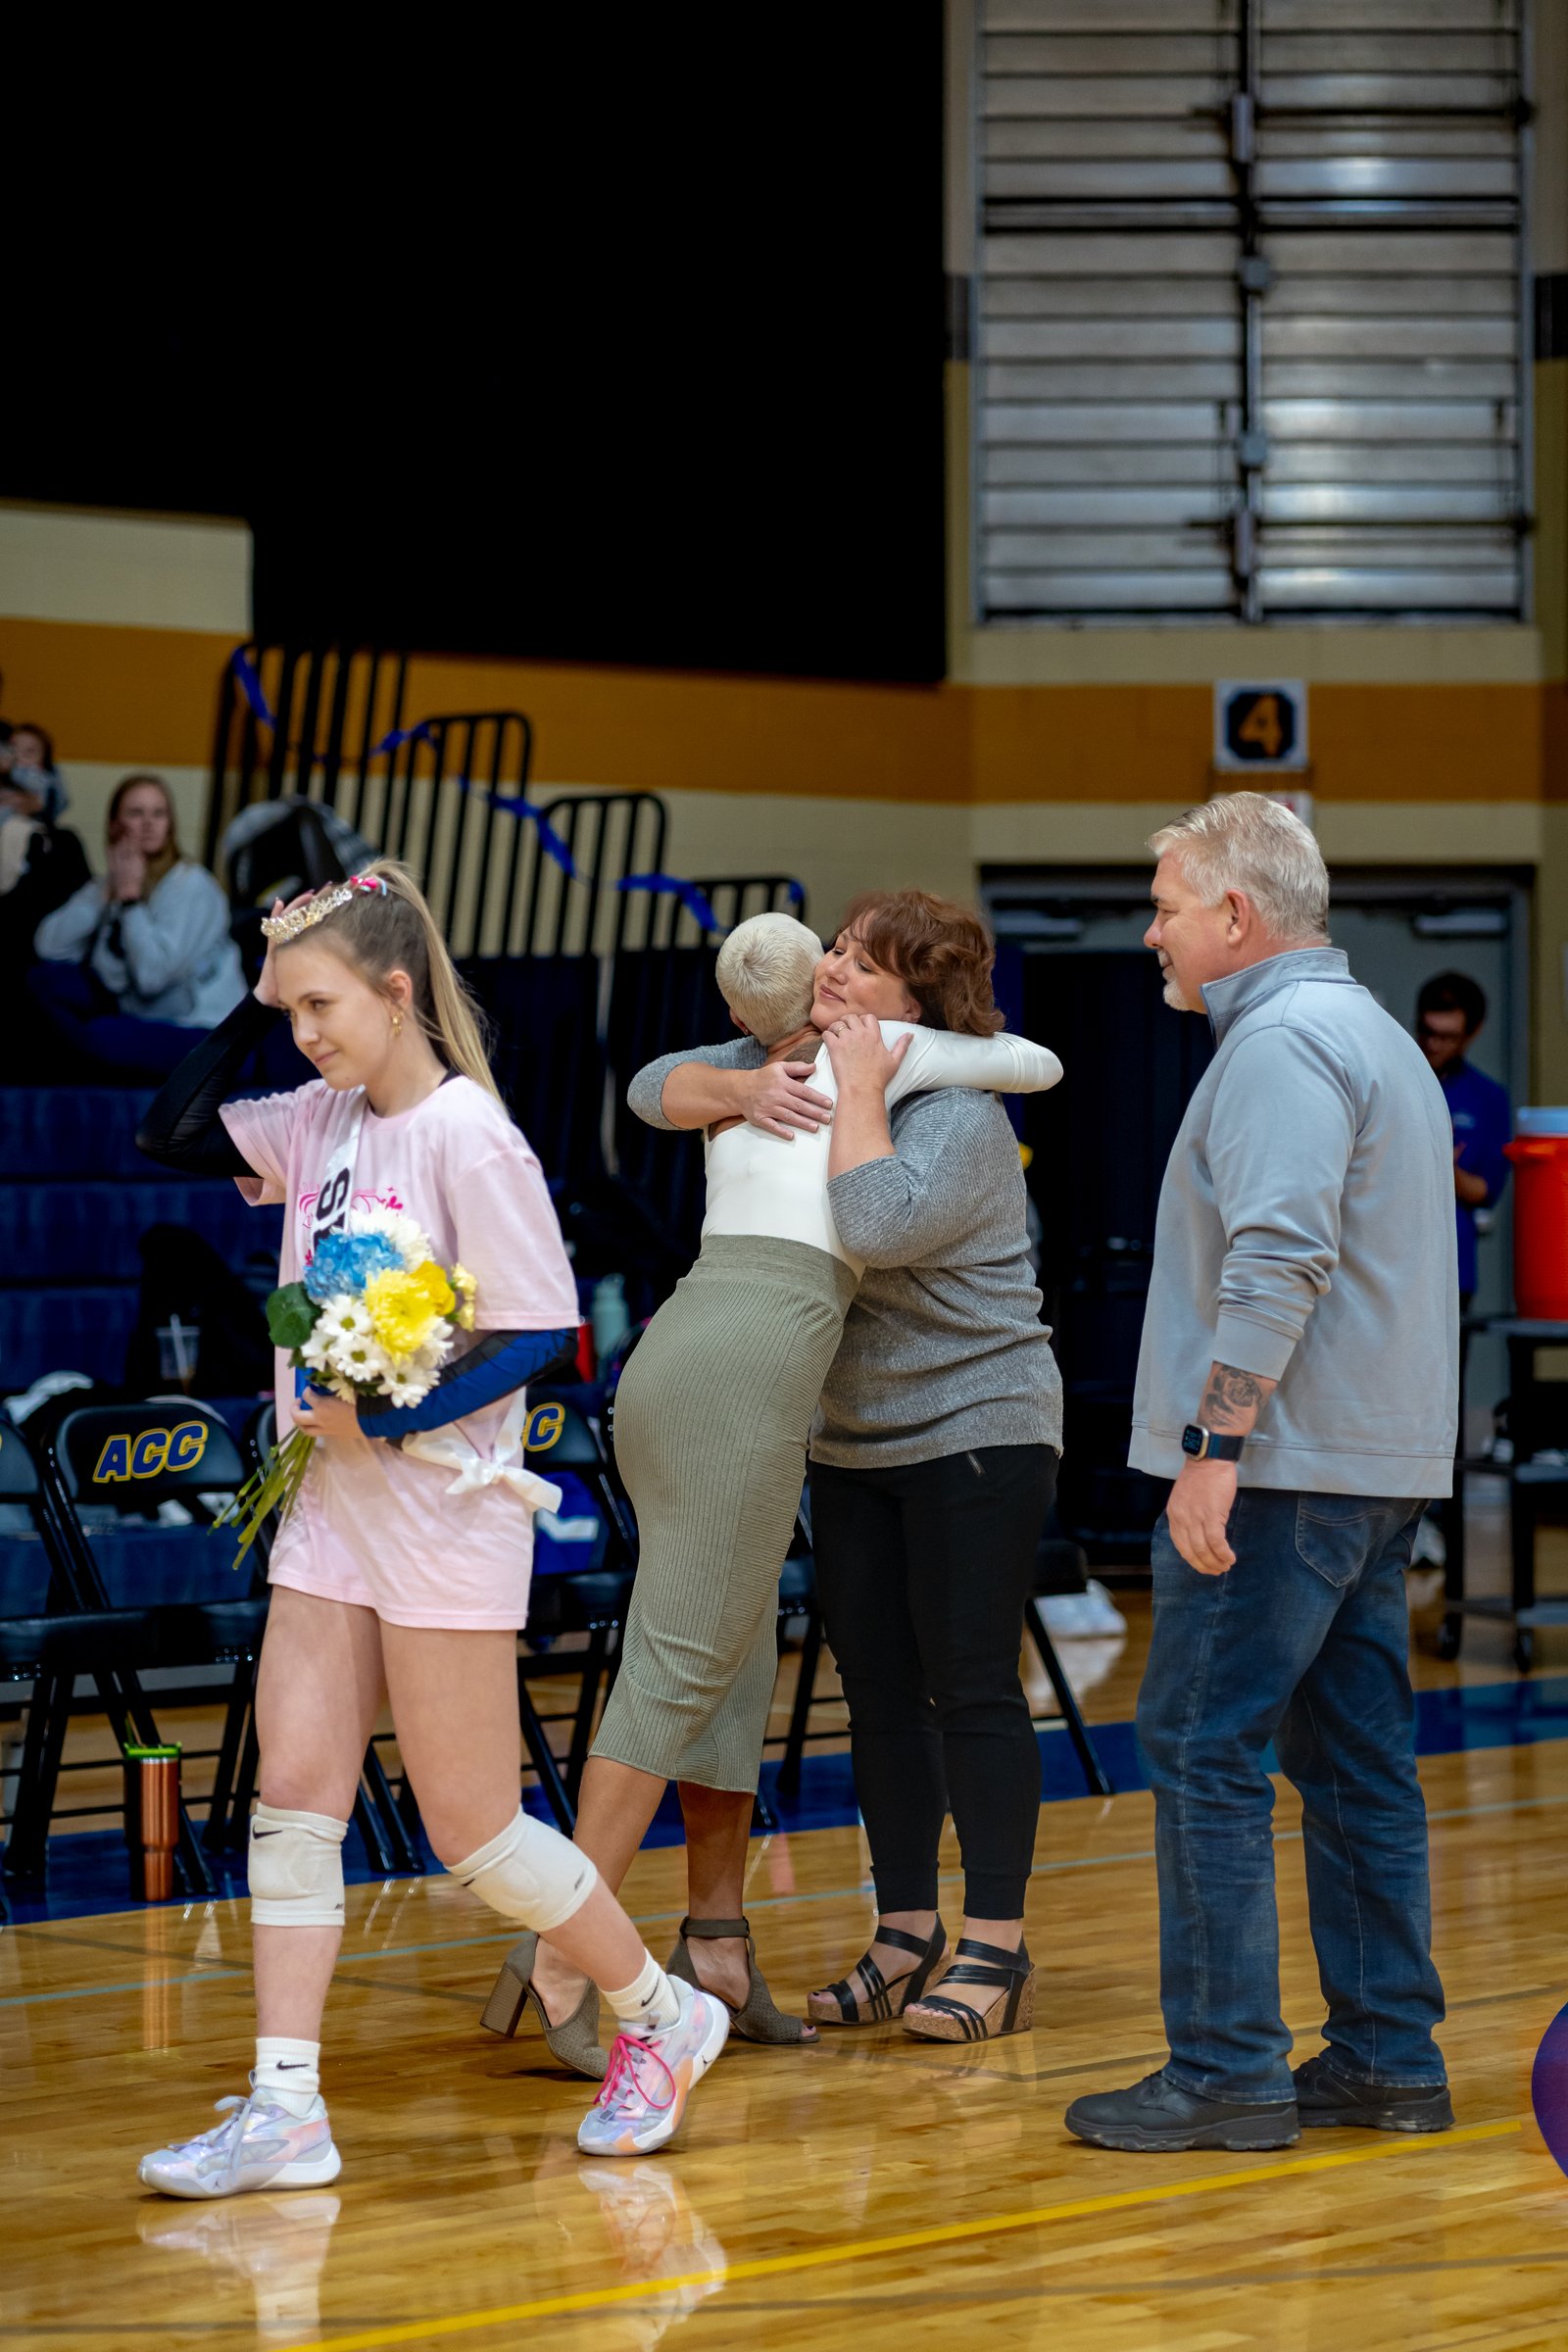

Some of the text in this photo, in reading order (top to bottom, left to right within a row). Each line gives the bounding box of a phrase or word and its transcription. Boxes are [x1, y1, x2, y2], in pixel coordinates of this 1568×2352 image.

[1238, 693, 1283, 758] 4
[92, 1420, 209, 1484] ACC
[520, 1402, 565, 1451] C
